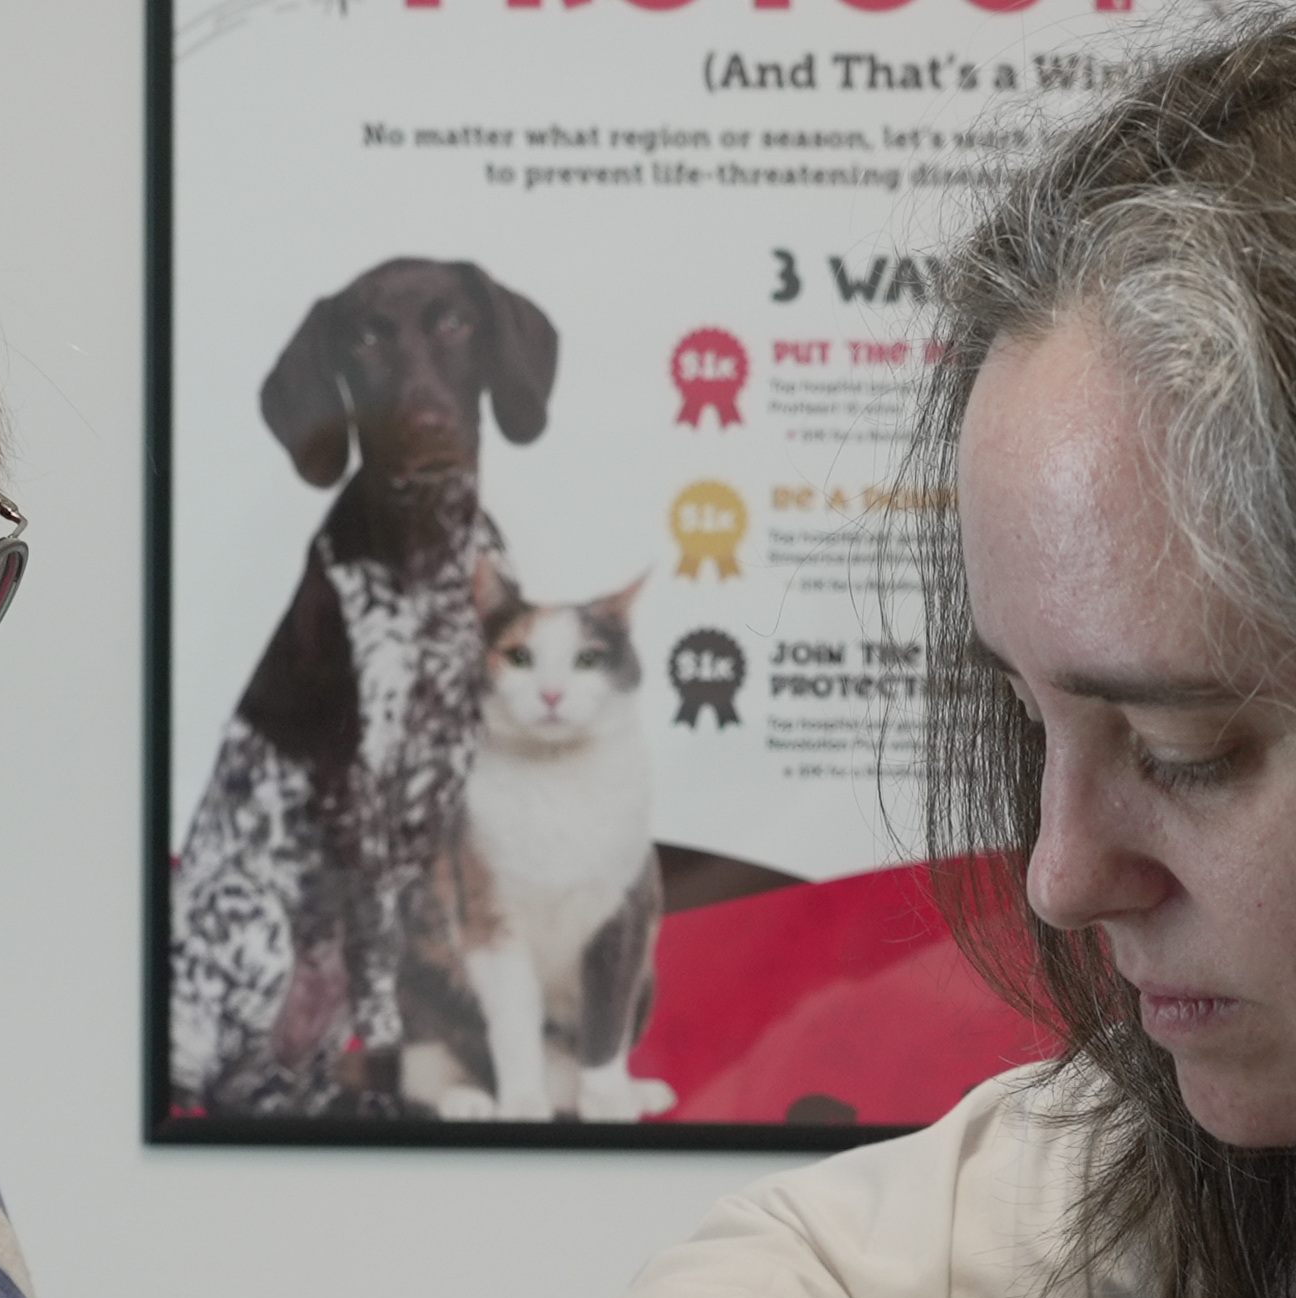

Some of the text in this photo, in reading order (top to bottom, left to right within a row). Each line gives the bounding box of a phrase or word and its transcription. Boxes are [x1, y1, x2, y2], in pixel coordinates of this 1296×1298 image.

[703, 52, 817, 91] (And
[993, 64, 1019, 91] a
[362, 122, 405, 146] No
[413, 126, 514, 147] matter
[525, 123, 600, 147] what
[610, 125, 711, 154] region
[719, 130, 751, 148] or
[760, 130, 872, 152] season,
[485, 163, 516, 184] to
[524, 164, 643, 191] prevent
[652, 162, 901, 192] life-threatening
[769, 247, 802, 304] 3
